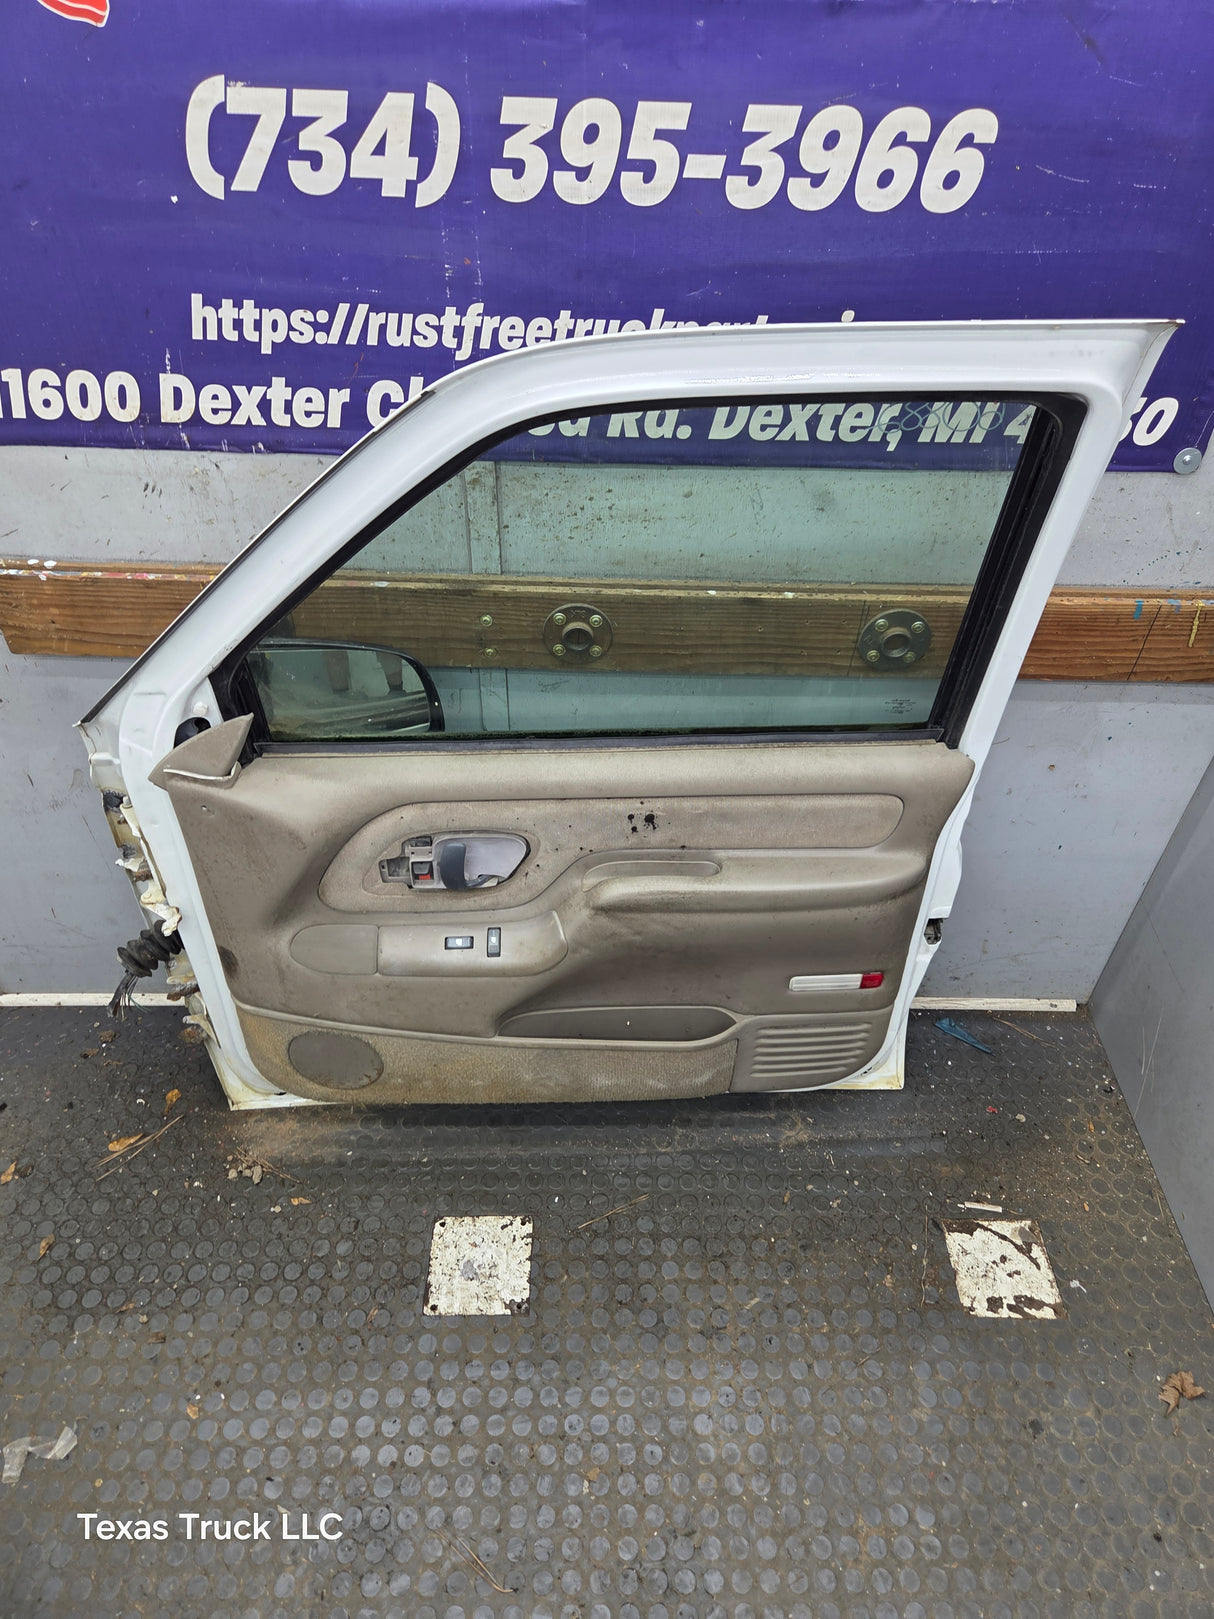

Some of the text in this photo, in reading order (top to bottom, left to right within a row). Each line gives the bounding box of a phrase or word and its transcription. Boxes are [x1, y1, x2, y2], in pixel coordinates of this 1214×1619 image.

[185, 74, 999, 214] (734) 395-3966
[0, 368, 141, 423] 1600
[159, 372, 351, 429] Dexter
